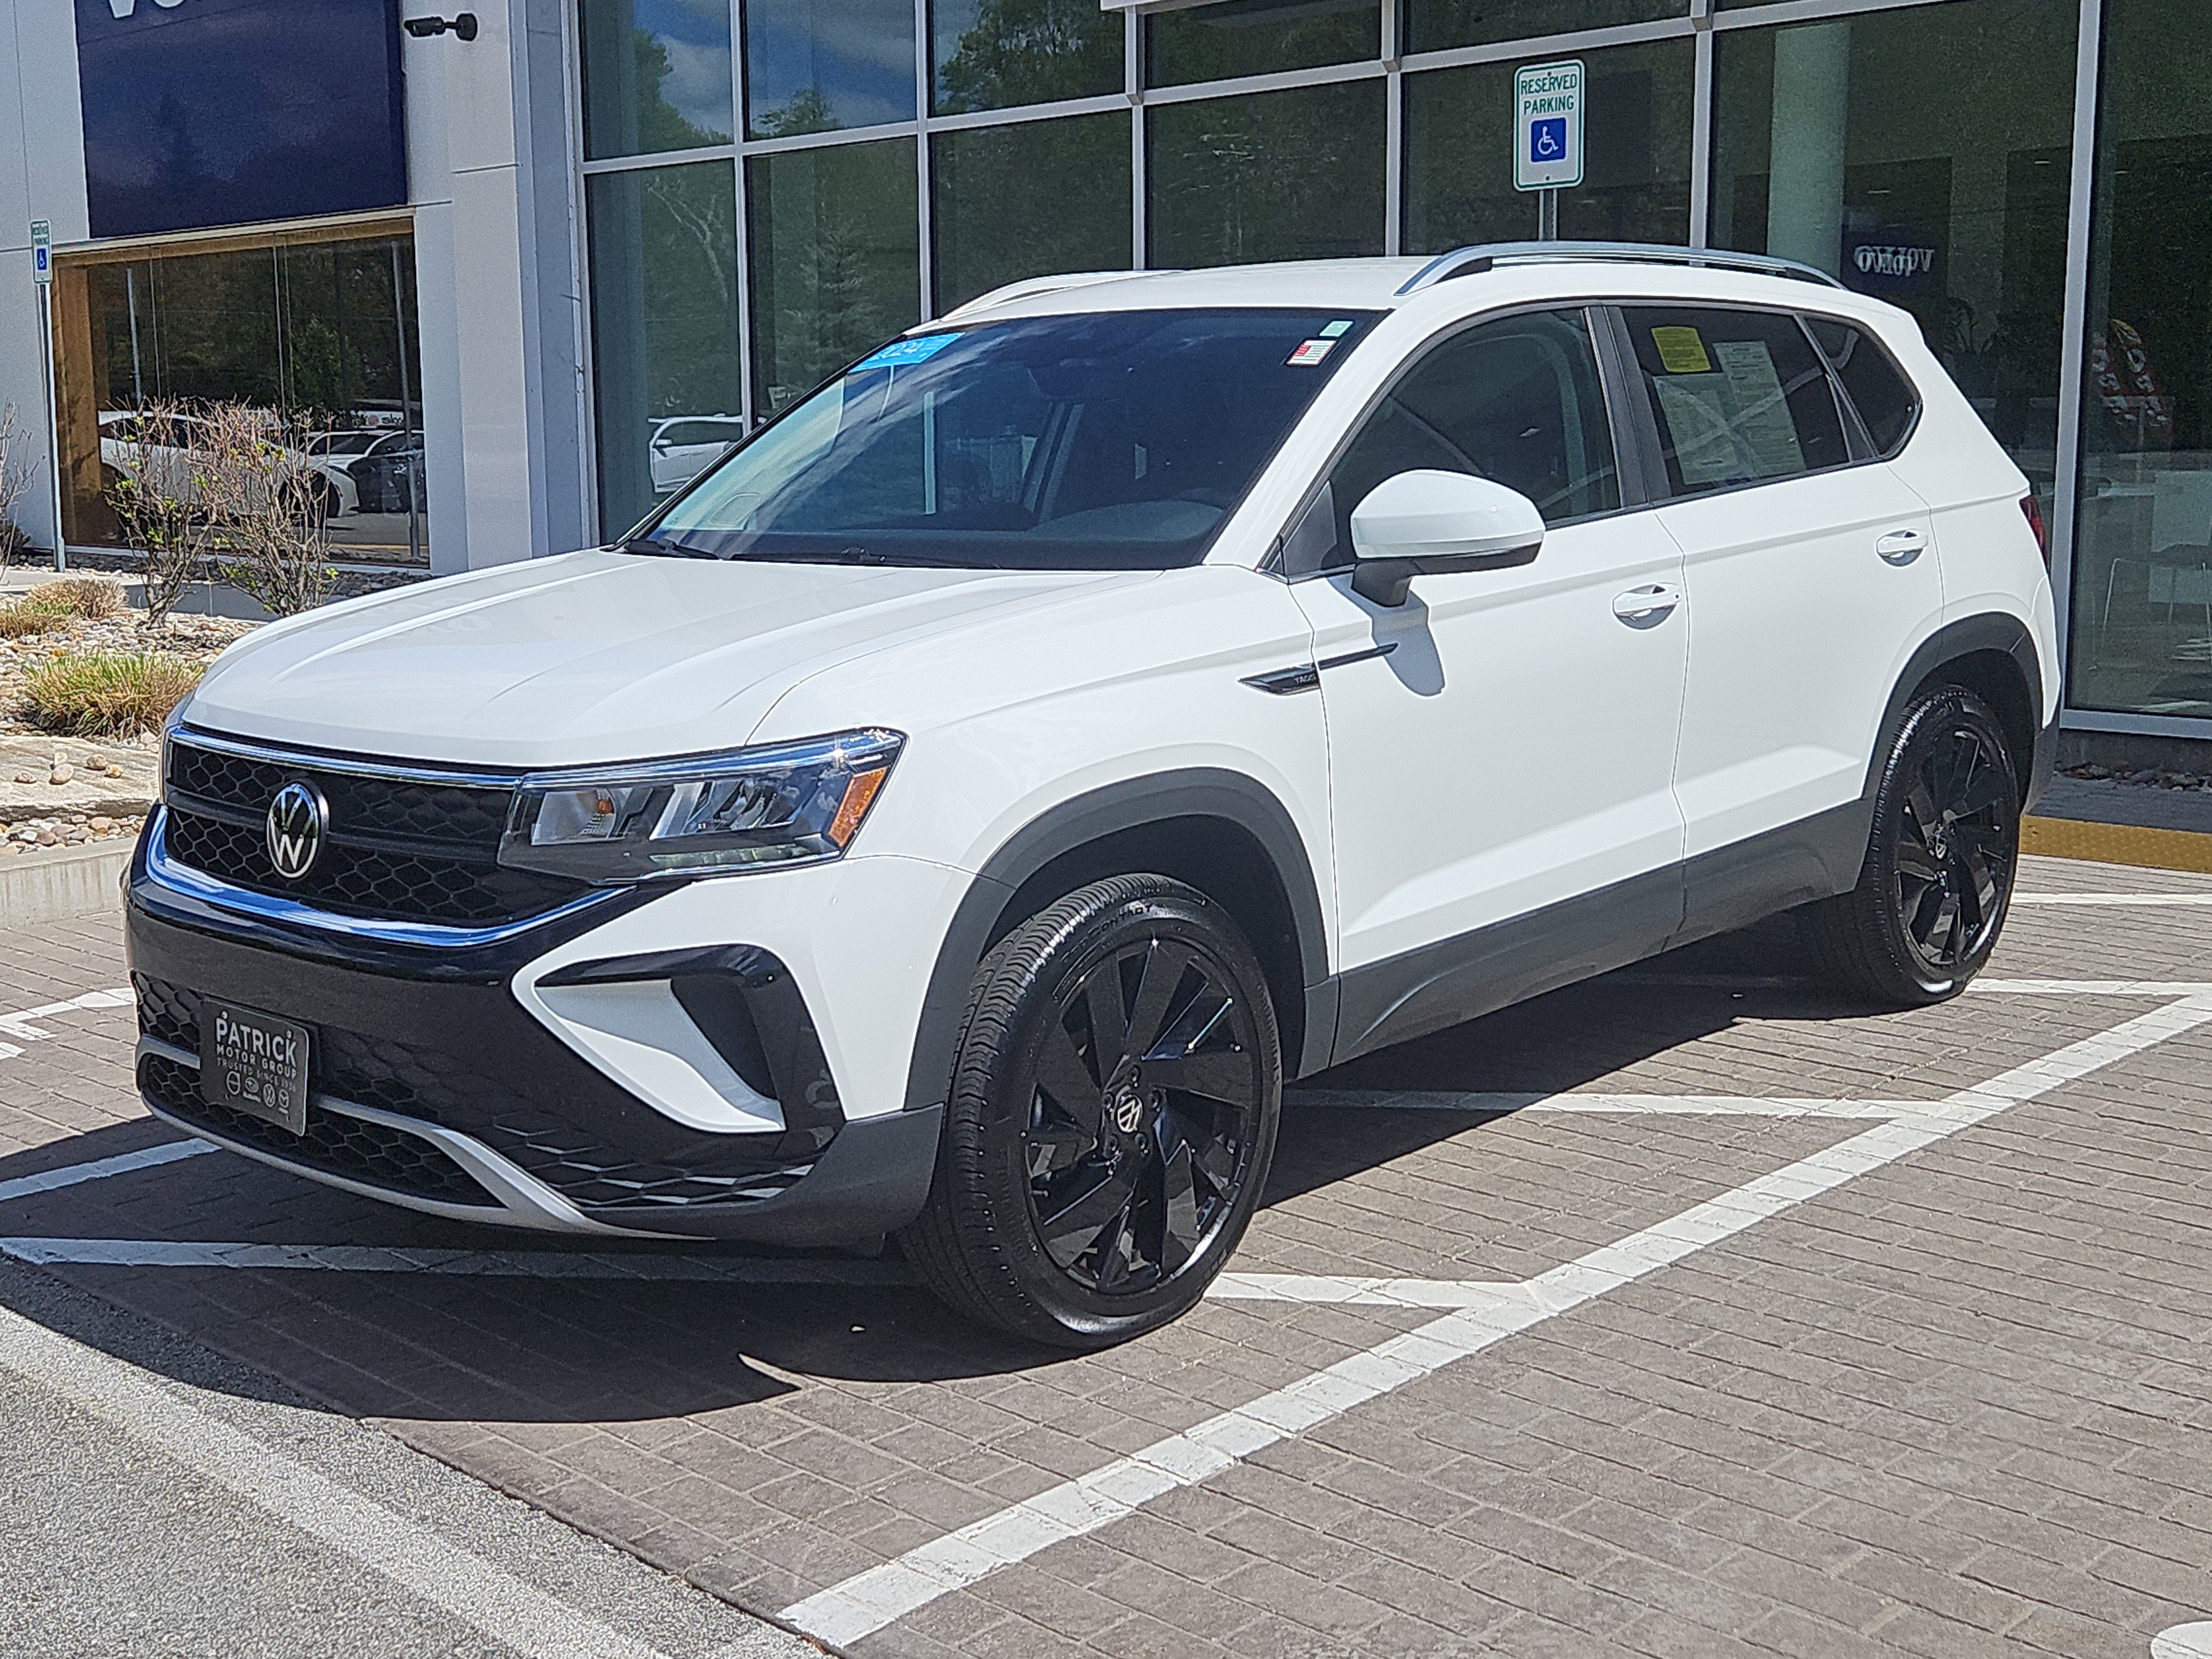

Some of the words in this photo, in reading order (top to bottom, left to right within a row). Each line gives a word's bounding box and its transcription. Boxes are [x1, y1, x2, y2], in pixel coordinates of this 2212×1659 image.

[1521, 74, 1577, 95] RESERVED
[1523, 95, 1574, 115] PARKING
[216, 1017, 297, 1067] PATRICK
[217, 1044, 255, 1065] MOTOR
[262, 1058, 297, 1079] GROUP
